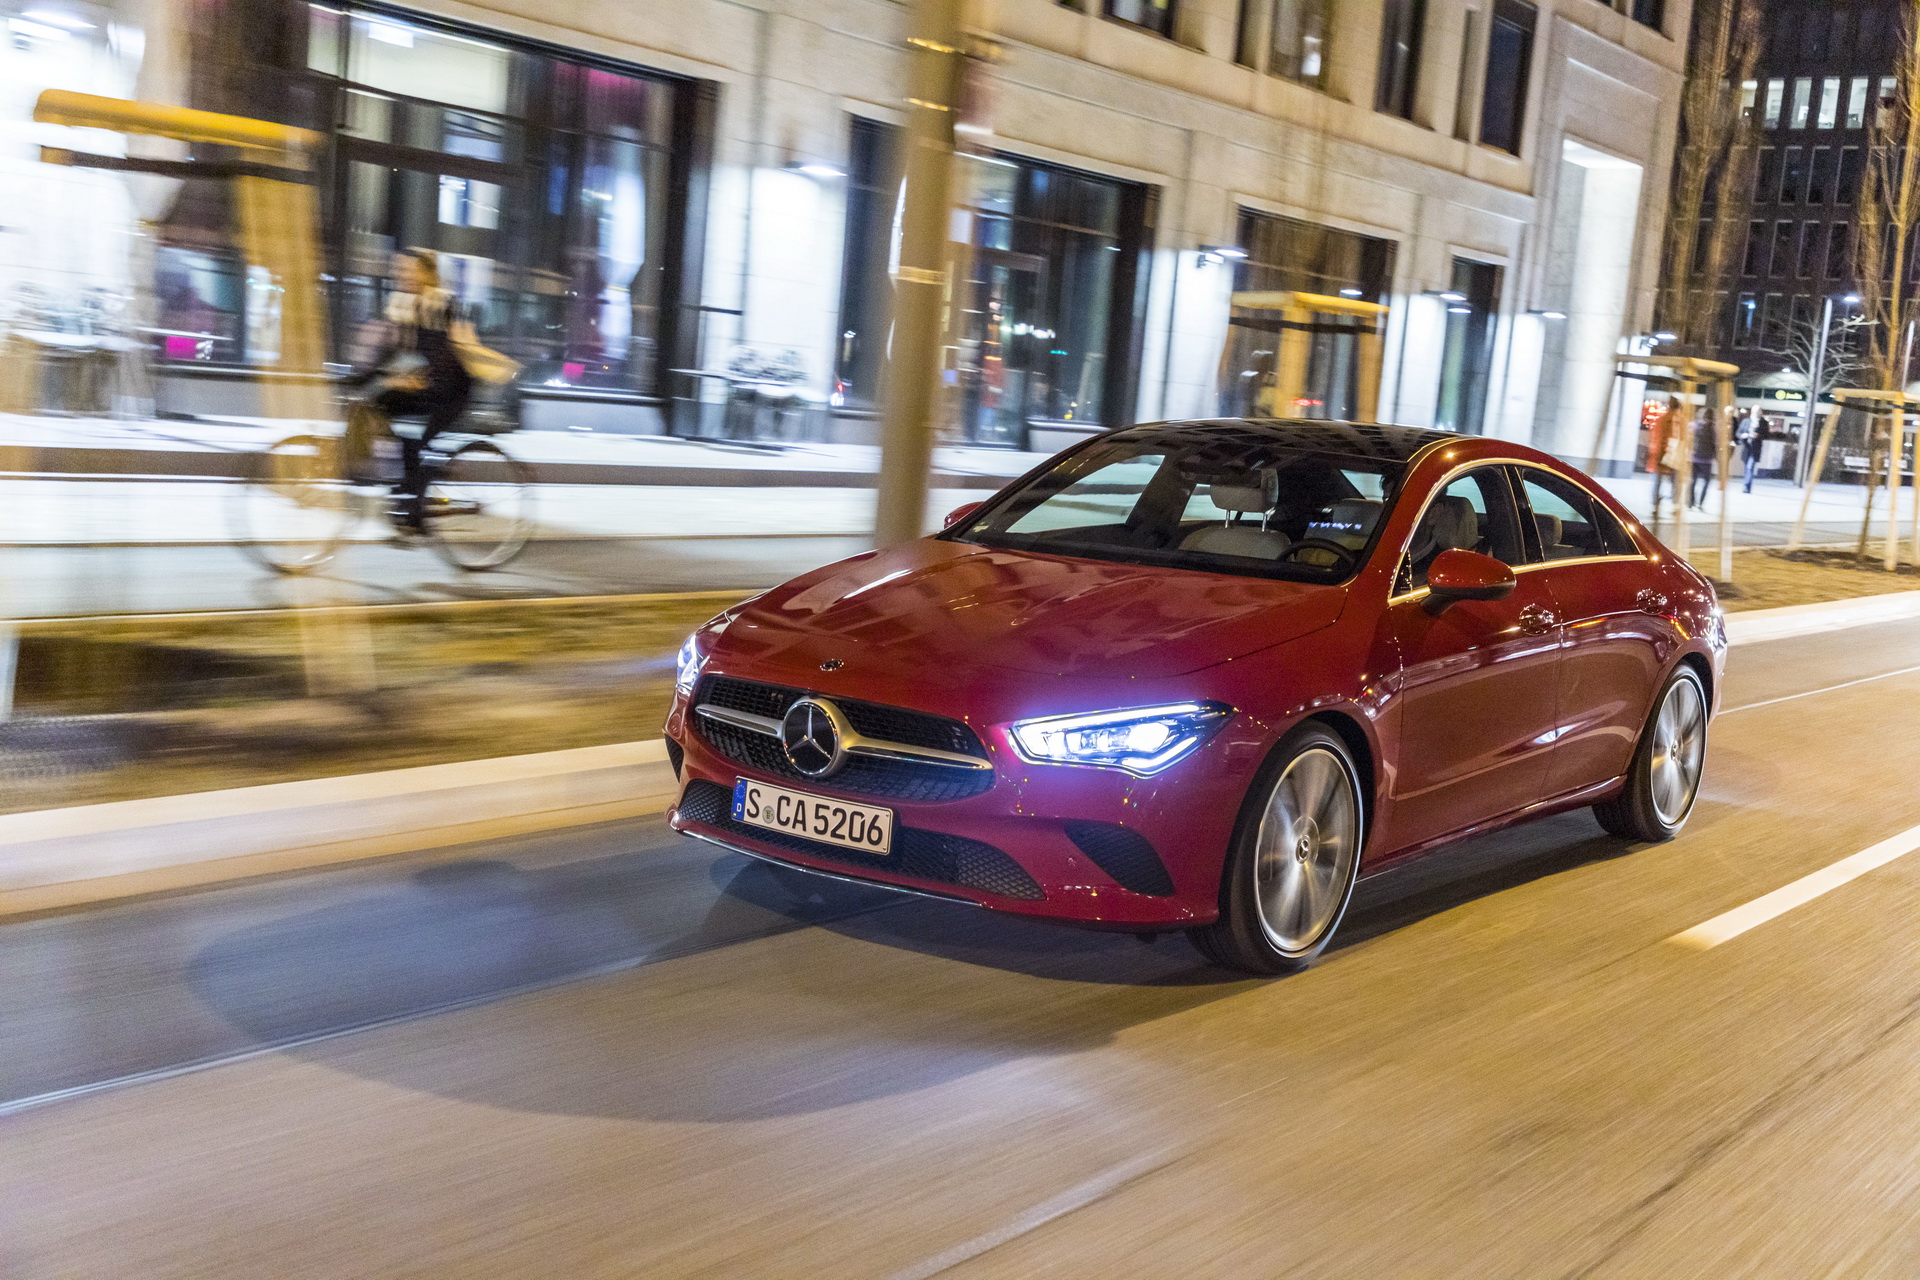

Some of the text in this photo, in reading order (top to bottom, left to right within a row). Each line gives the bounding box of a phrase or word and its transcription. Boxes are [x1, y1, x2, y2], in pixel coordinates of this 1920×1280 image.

[746, 788, 884, 846] S CA 5206
